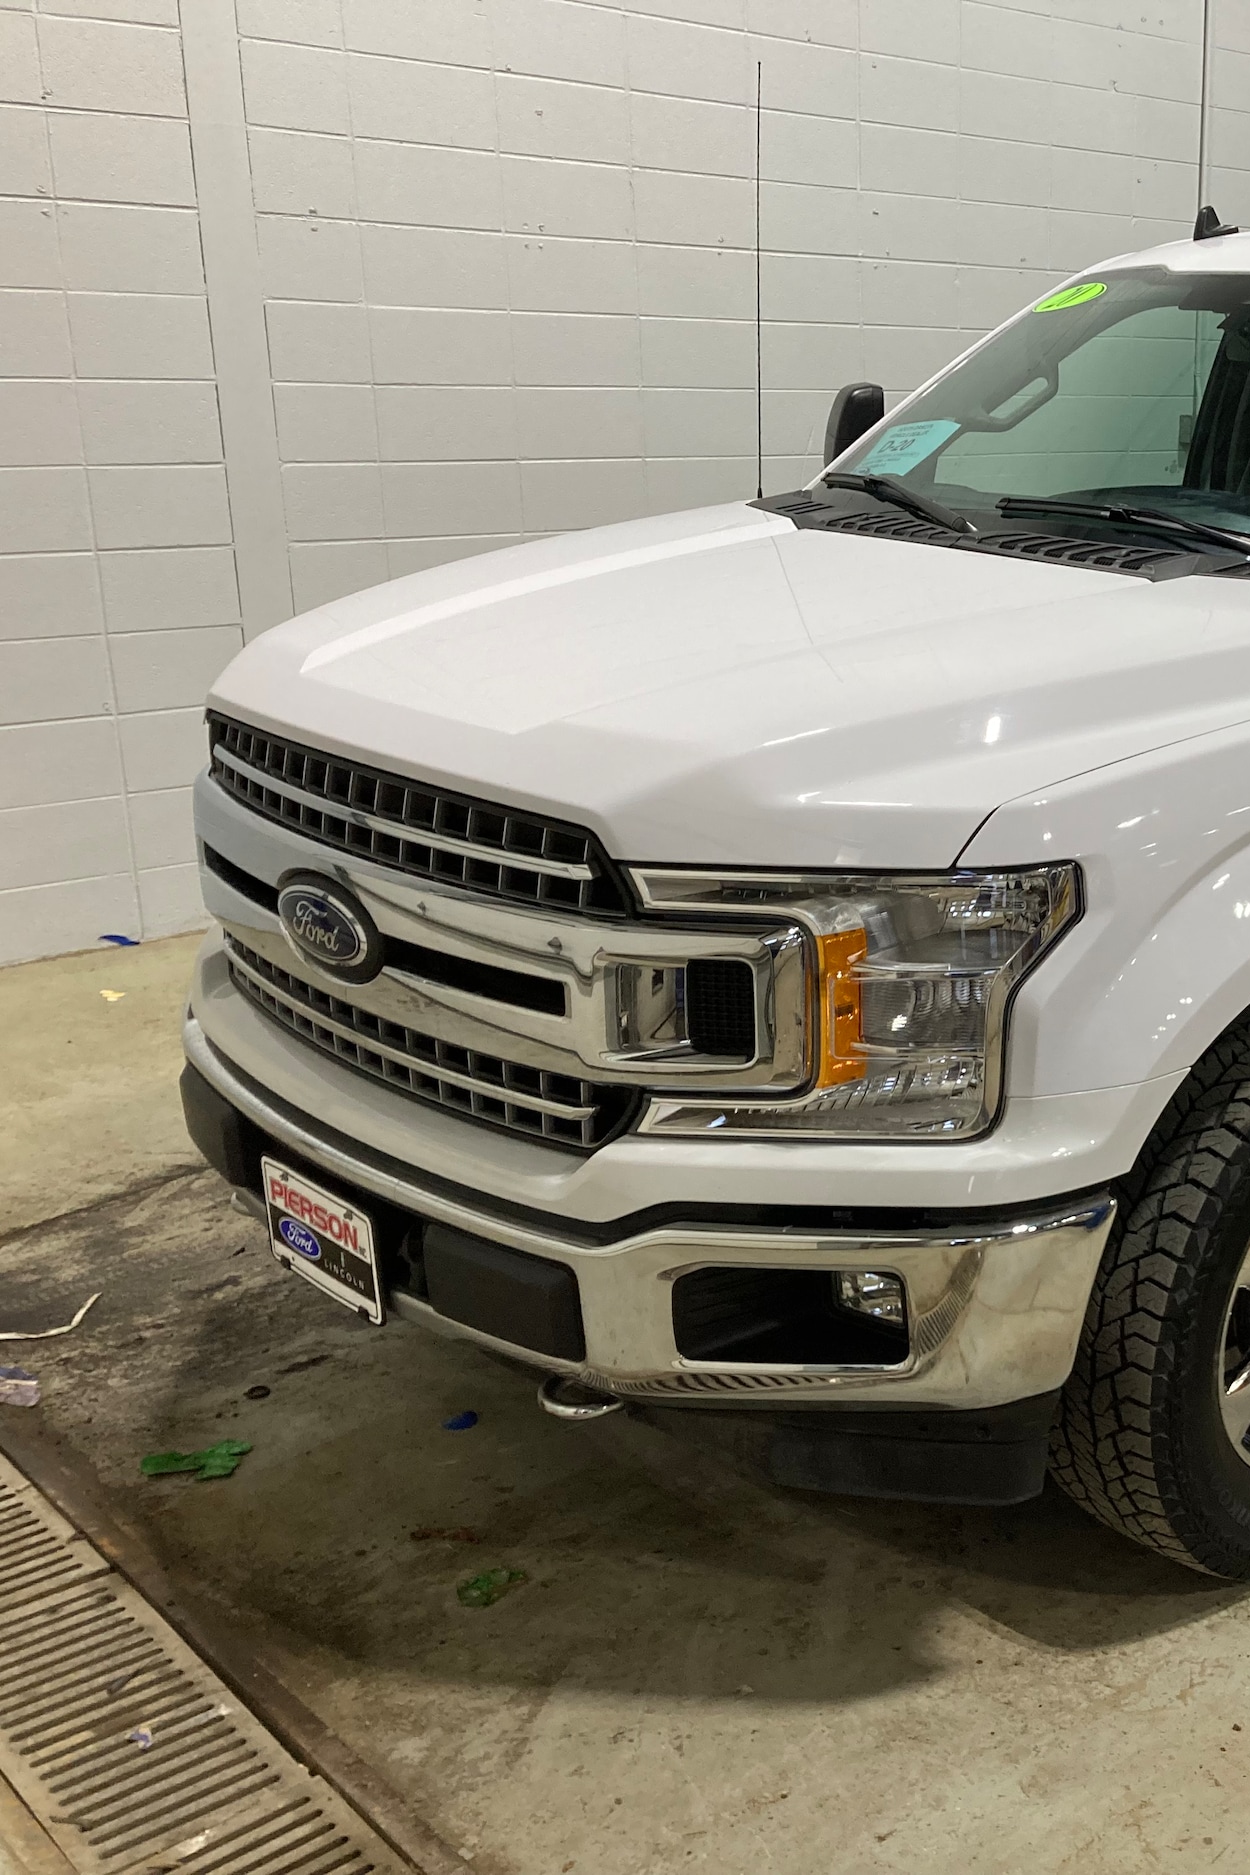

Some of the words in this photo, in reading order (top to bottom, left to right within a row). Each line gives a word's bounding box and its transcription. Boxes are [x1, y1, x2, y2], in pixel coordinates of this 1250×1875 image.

[1040, 283, 1099, 310] 20
[877, 439, 916, 454] D-20
[293, 900, 340, 952] Ford
[269, 1176, 359, 1251] PIERSON
[287, 1222, 314, 1254] Ford
[324, 1258, 366, 1291] LINCOLN
